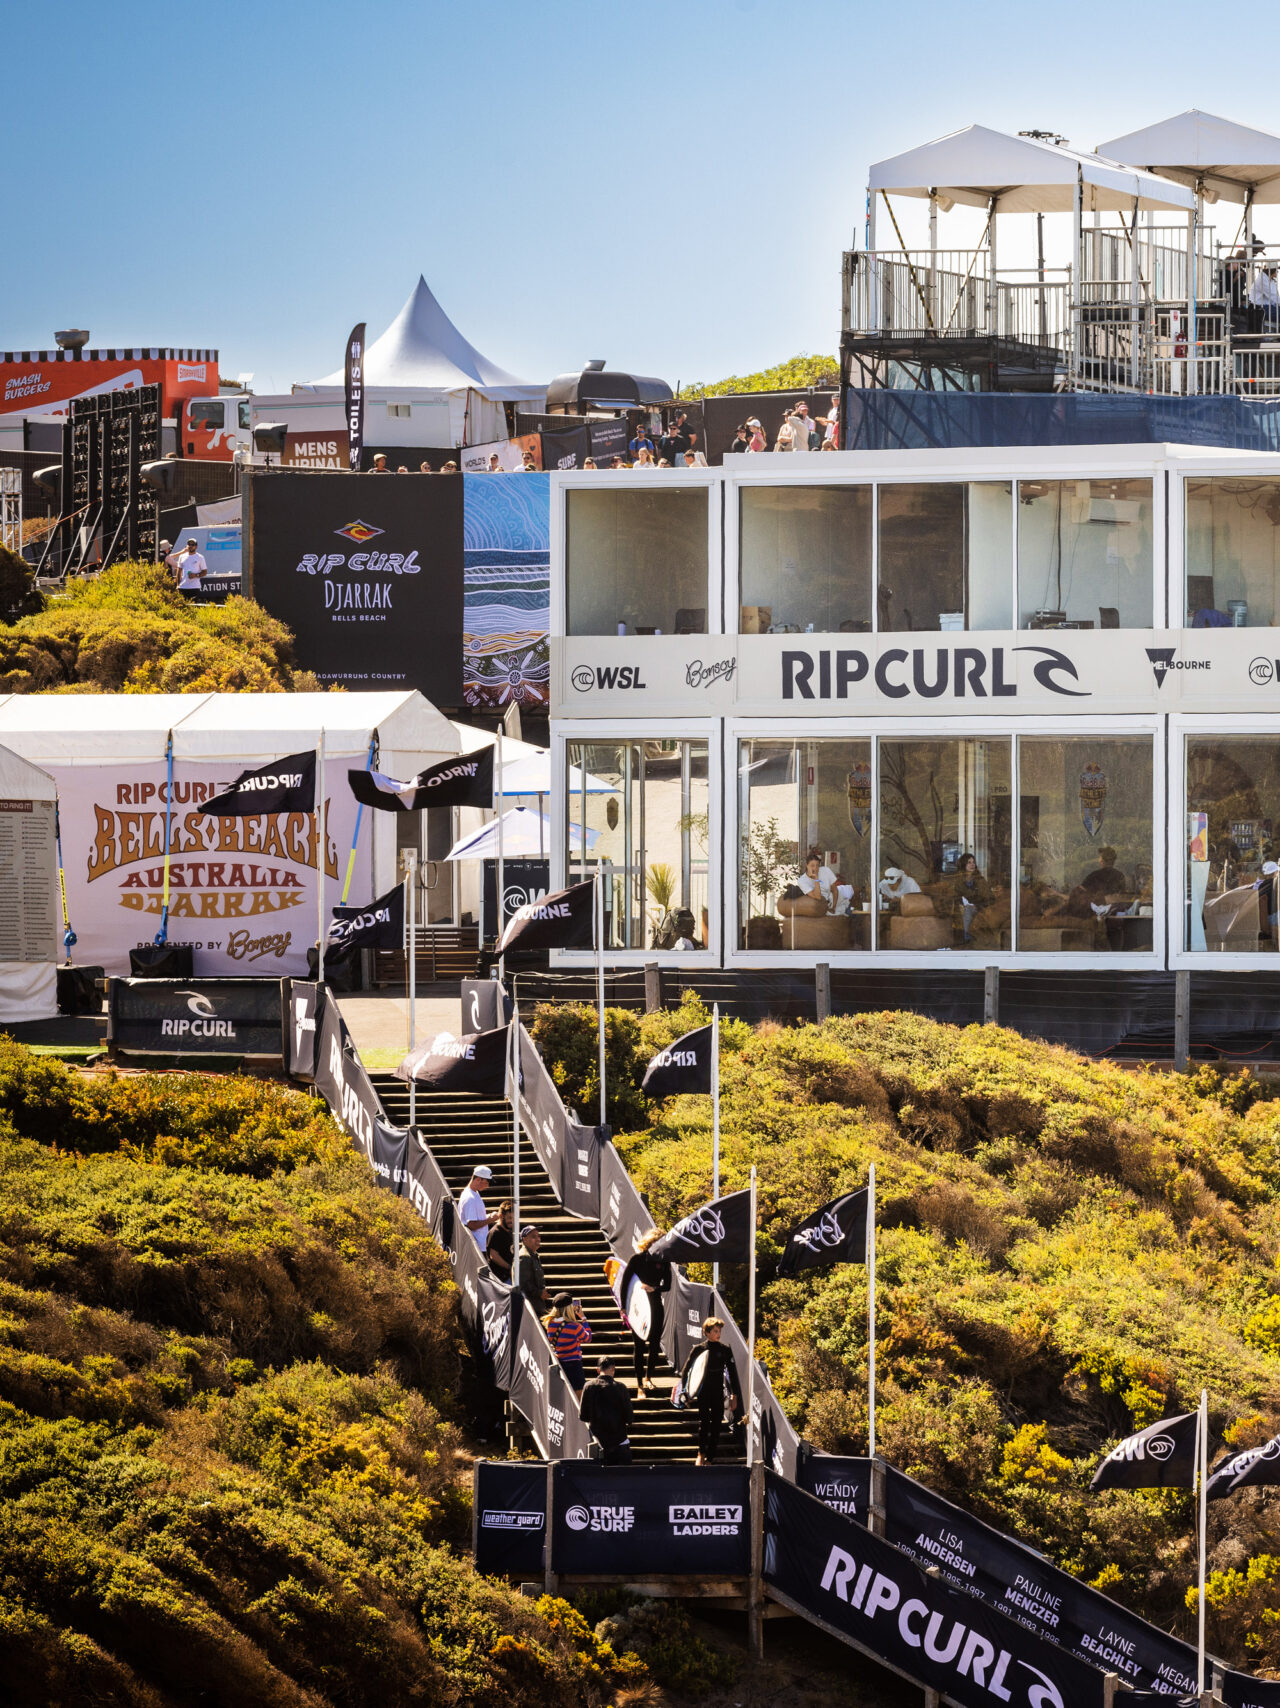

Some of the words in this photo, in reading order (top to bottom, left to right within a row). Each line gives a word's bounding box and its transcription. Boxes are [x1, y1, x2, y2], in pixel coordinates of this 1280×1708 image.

[4, 382, 51, 400] BURGERS
[5, 373, 41, 389] SMASH
[350, 366, 361, 442] TOILETS
[294, 441, 337, 457] MENS
[464, 456, 486, 468] WORLD'S
[557, 453, 577, 470] SURF
[296, 553, 345, 575] RIP
[348, 550, 421, 575] CURL
[200, 583, 228, 592] ATION
[359, 614, 386, 622] BEACH
[685, 655, 736, 689] Bonsoy
[782, 648, 1017, 699] RIPCURL
[1150, 660, 1211, 670] MELBOURNE
[597, 666, 646, 689] WSL
[418, 763, 479, 788] OURNE
[87, 803, 209, 884] BELLS
[213, 797, 339, 881] BEACH
[118, 862, 306, 887] AUSTRALIA
[117, 891, 307, 919] DJARRAK
[137, 941, 203, 950] PREENTED
[207, 941, 222, 949] BY
[226, 928, 292, 962] Bonsoy
[161, 1019, 236, 1037] RIPCURL
[409, 1172, 432, 1224] YETI
[815, 1483, 859, 1498] WENDY
[484, 1514, 516, 1526] weather
[517, 1515, 540, 1528] guard
[589, 1506, 634, 1520] TRUE
[673, 1508, 739, 1520] BAILEY
[590, 1519, 634, 1532] SURF
[673, 1525, 739, 1536] LADDERS
[939, 1528, 963, 1553] LISA
[915, 1533, 977, 1577] ANDERSEN
[965, 1583, 986, 1599] 1997
[1014, 1574, 1062, 1611] PAULINE
[993, 1600, 1012, 1616] 1991
[1004, 1587, 1060, 1628] MENCZER
[820, 1544, 1012, 1702] RIPCURL
[1098, 1626, 1137, 1657] LAYNE
[1080, 1633, 1142, 1677] BEACHLEY
[1157, 1662, 1199, 1694] MEGAN
